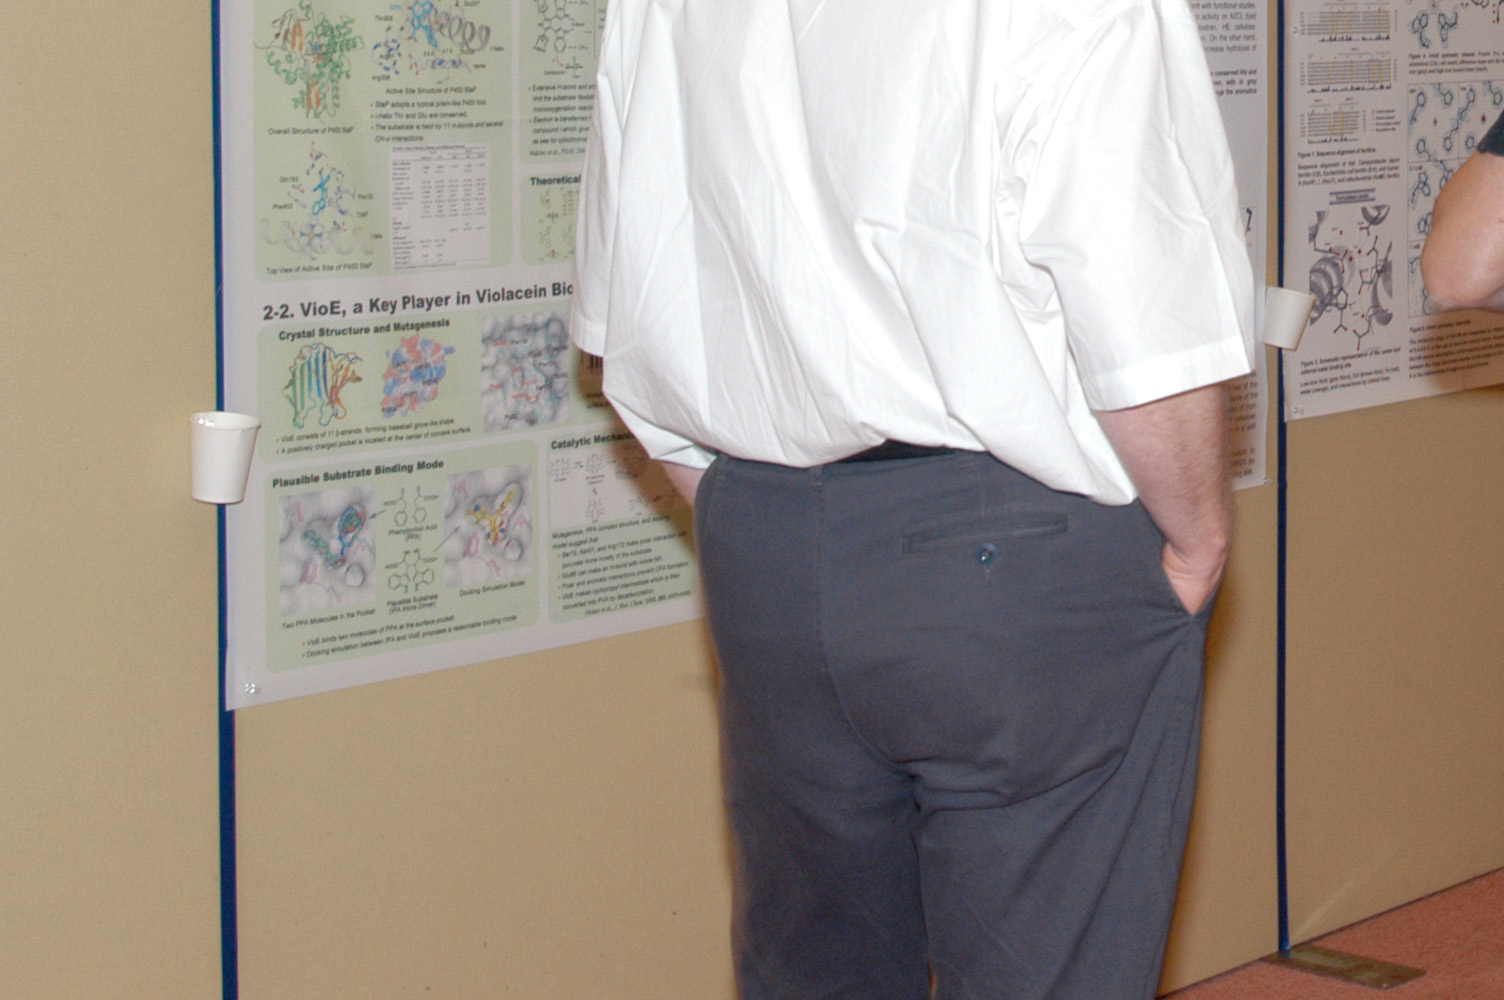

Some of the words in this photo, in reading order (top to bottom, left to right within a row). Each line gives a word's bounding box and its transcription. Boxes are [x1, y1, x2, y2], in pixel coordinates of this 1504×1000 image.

[530, 174, 582, 187] Theoretical
[264, 304, 296, 321] 2-2.
[300, 300, 349, 318] VioE,
[352, 303, 363, 315] a
[368, 298, 397, 316] Key
[401, 295, 449, 312] Player
[455, 291, 470, 306] in
[476, 284, 546, 304] Violacein
[279, 328, 315, 342] Crystal
[318, 325, 370, 337] Structure
[373, 322, 390, 333] and
[392, 318, 450, 333] Mutagenesis
[272, 473, 319, 488] Plausible
[322, 467, 372, 482] Substrate
[373, 464, 414, 477] Binding
[416, 460, 444, 473] Mode
